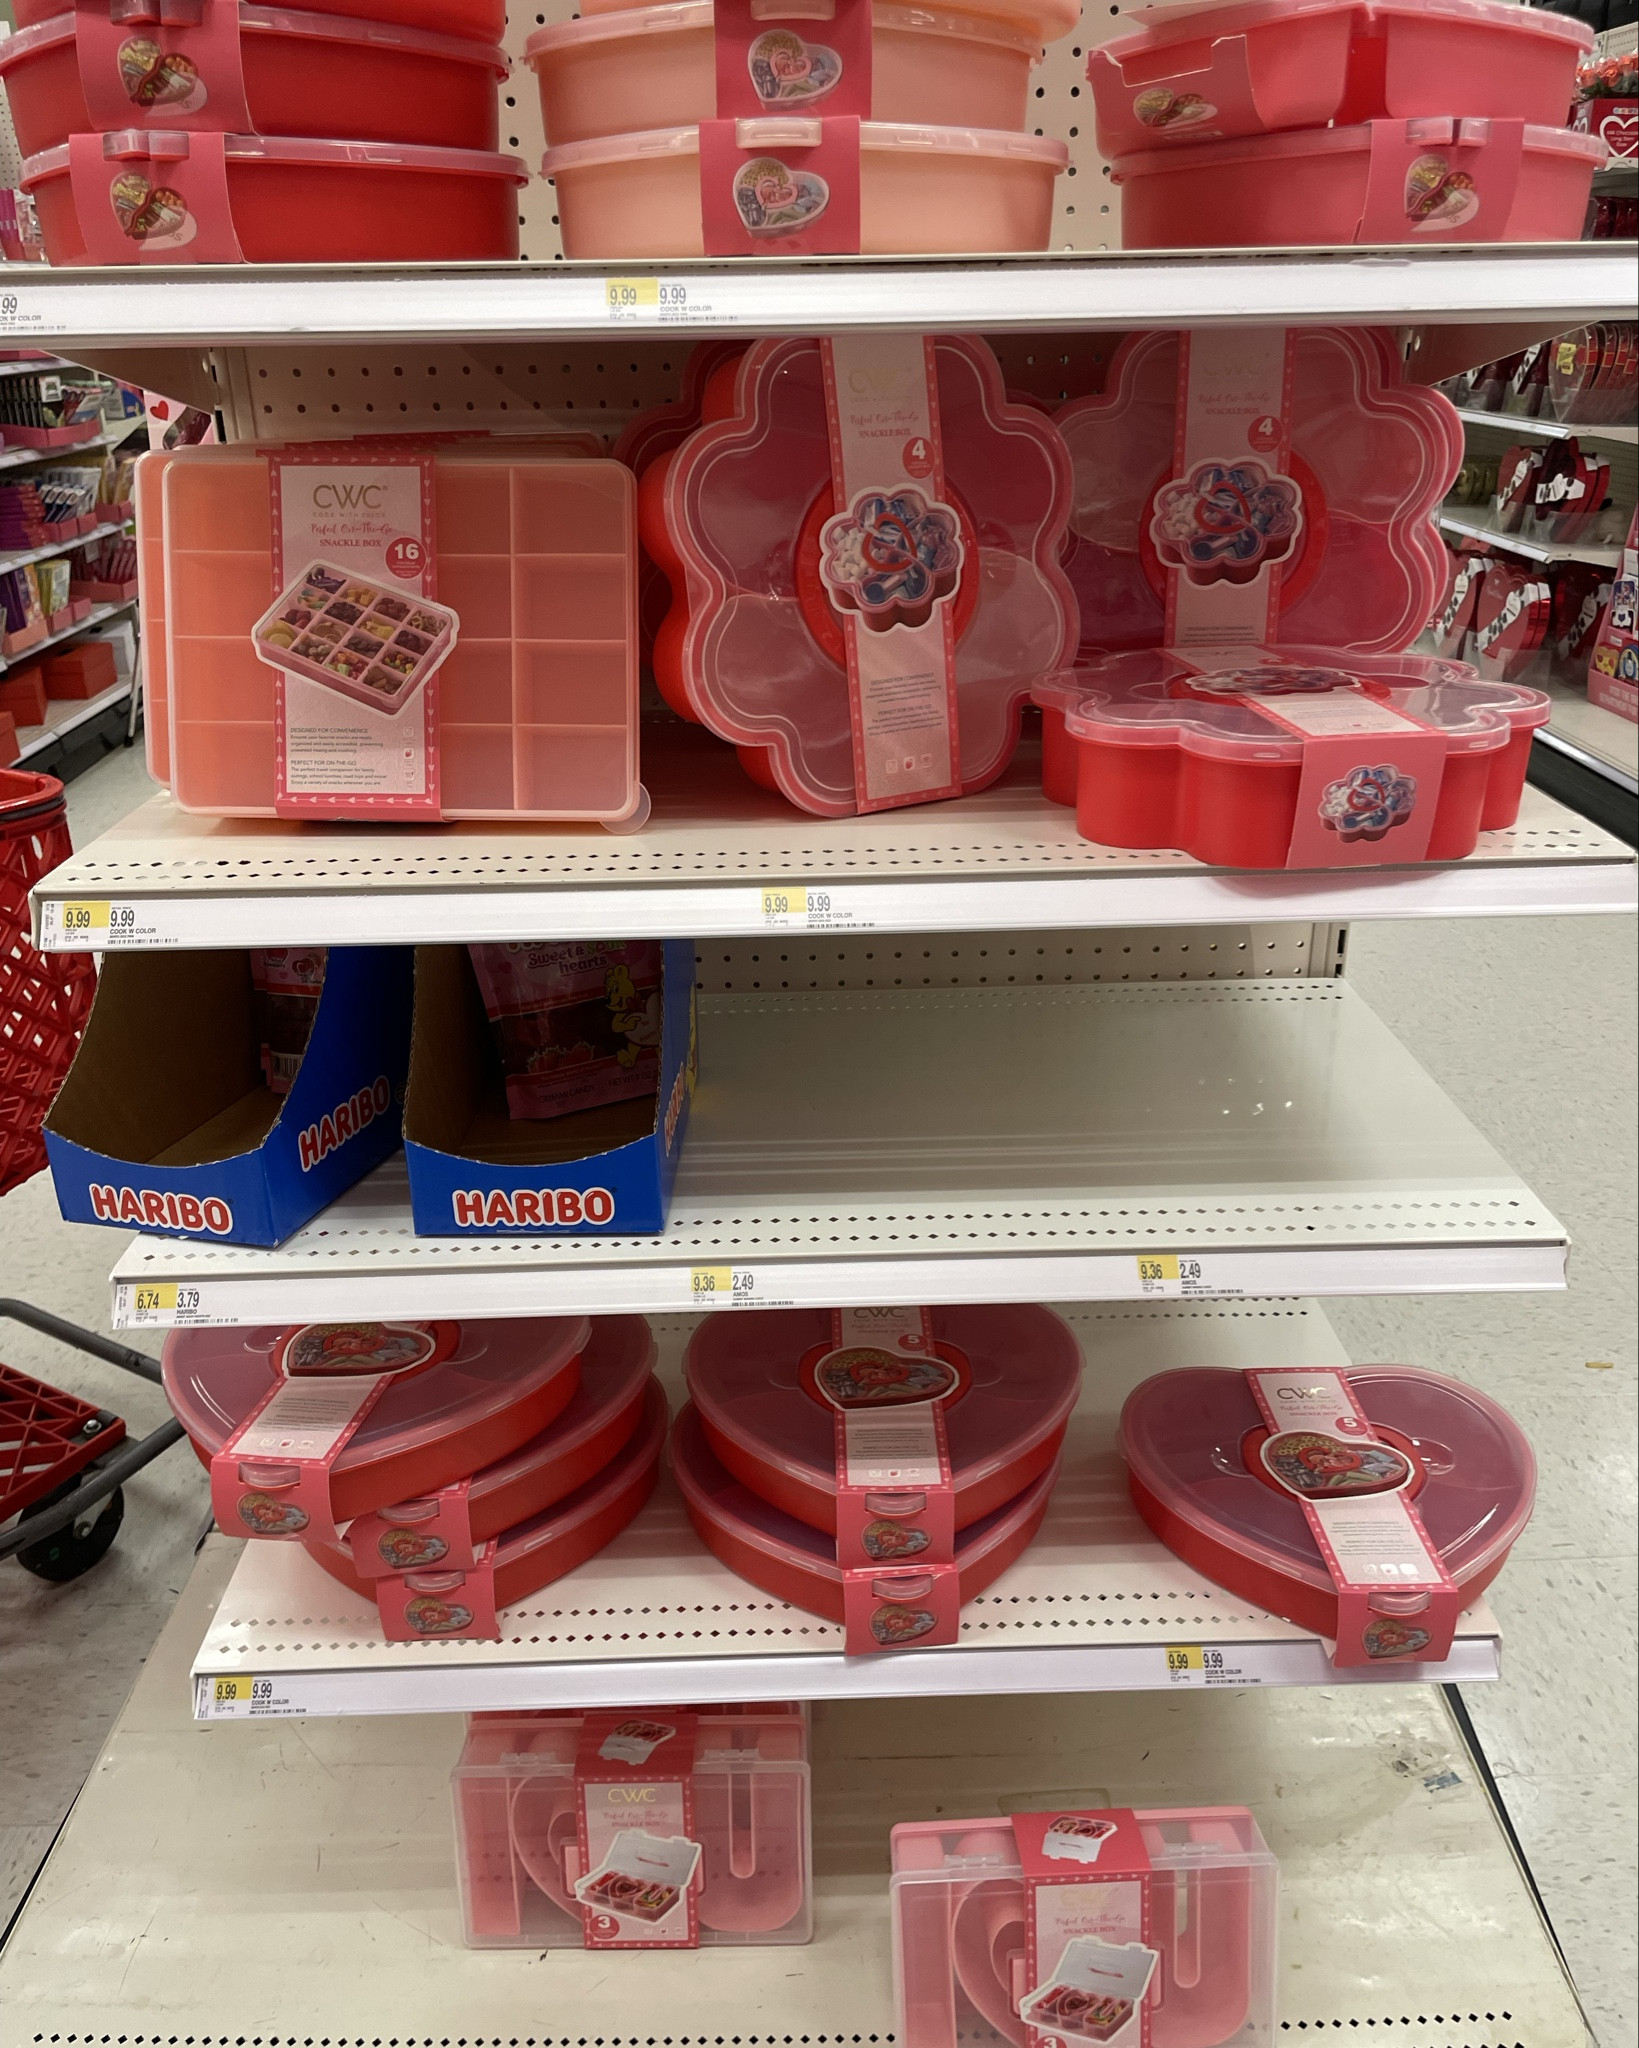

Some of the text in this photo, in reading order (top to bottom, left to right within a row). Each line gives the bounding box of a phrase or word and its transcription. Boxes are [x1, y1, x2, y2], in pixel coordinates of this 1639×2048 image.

[610, 288, 637, 305] 9.99
[660, 288, 686, 304] 9.99
[1258, 418, 1274, 436] 4
[912, 440, 926, 460] 4
[313, 484, 382, 510] CWC
[395, 544, 420, 560] 16
[765, 897, 788, 912] 9.99
[808, 896, 830, 912] 9.99
[66, 911, 90, 928] 9.99
[110, 910, 134, 927] 9.99
[528, 947, 572, 966] Sweet
[559, 956, 607, 974] hearts
[300, 1076, 390, 1172] HARIBO
[90, 1184, 232, 1234] HARIBO
[454, 1188, 614, 1226] HARIBO
[1141, 1264, 1162, 1280] 9.36
[1180, 1263, 1201, 1278] 2.49
[694, 1276, 715, 1292] 9.36
[732, 1274, 754, 1290] 2.49
[138, 1293, 159, 1309] 6.74
[177, 1292, 200, 1308] 3.79
[854, 1307, 904, 1318] CWC
[908, 1335, 920, 1343] 5
[1277, 1386, 1331, 1399] CWC
[1344, 1418, 1357, 1428] 5
[1169, 1653, 1188, 1669] 9.99
[1203, 1653, 1223, 1668] 9.99
[217, 1684, 236, 1699] 9.99
[253, 1683, 272, 1698] 9.99
[608, 1788, 656, 1802] CWC
[598, 1916, 611, 1928] 3
[1043, 2038, 1057, 2048] 3
